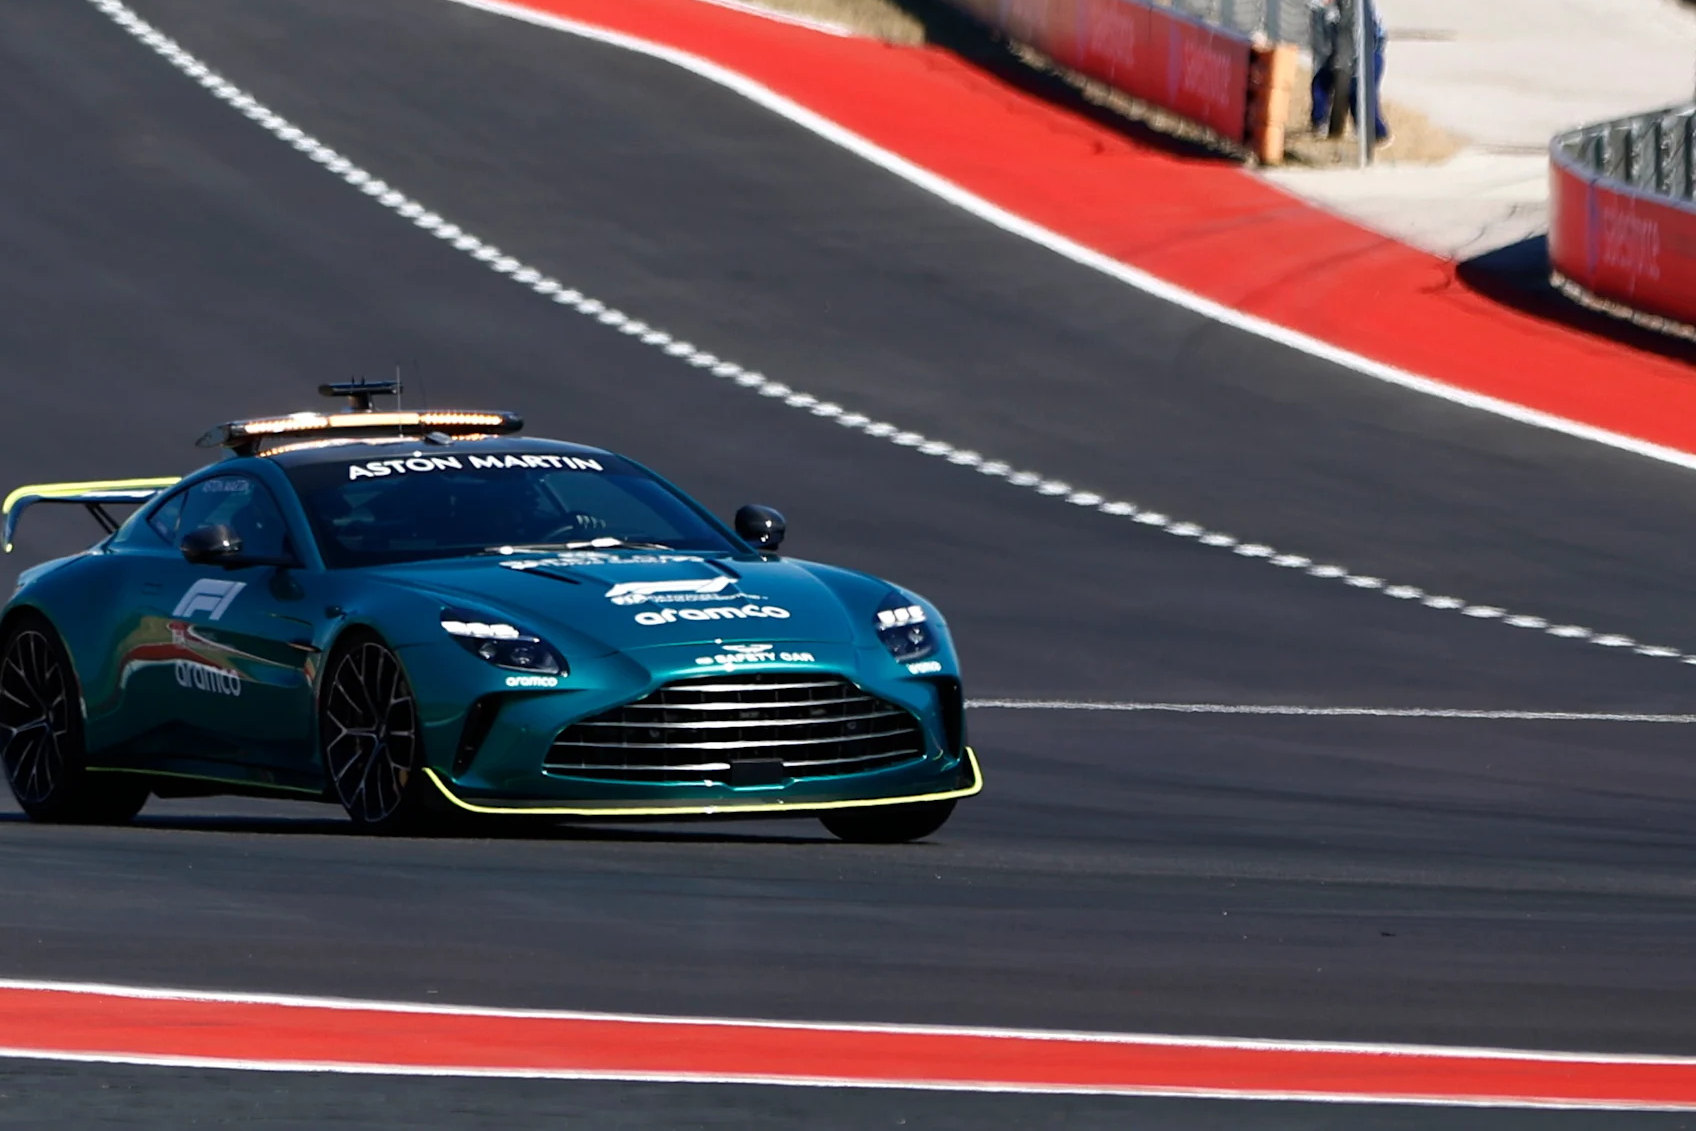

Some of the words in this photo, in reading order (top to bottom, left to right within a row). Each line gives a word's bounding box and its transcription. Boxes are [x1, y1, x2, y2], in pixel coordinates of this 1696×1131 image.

[349, 457, 463, 480] ASTON
[467, 454, 604, 472] MARTIN
[634, 604, 790, 626] aramco
[714, 652, 776, 665] SAFETY
[779, 652, 816, 662] CAR
[174, 660, 242, 697] aramco
[505, 676, 559, 688] aramco
